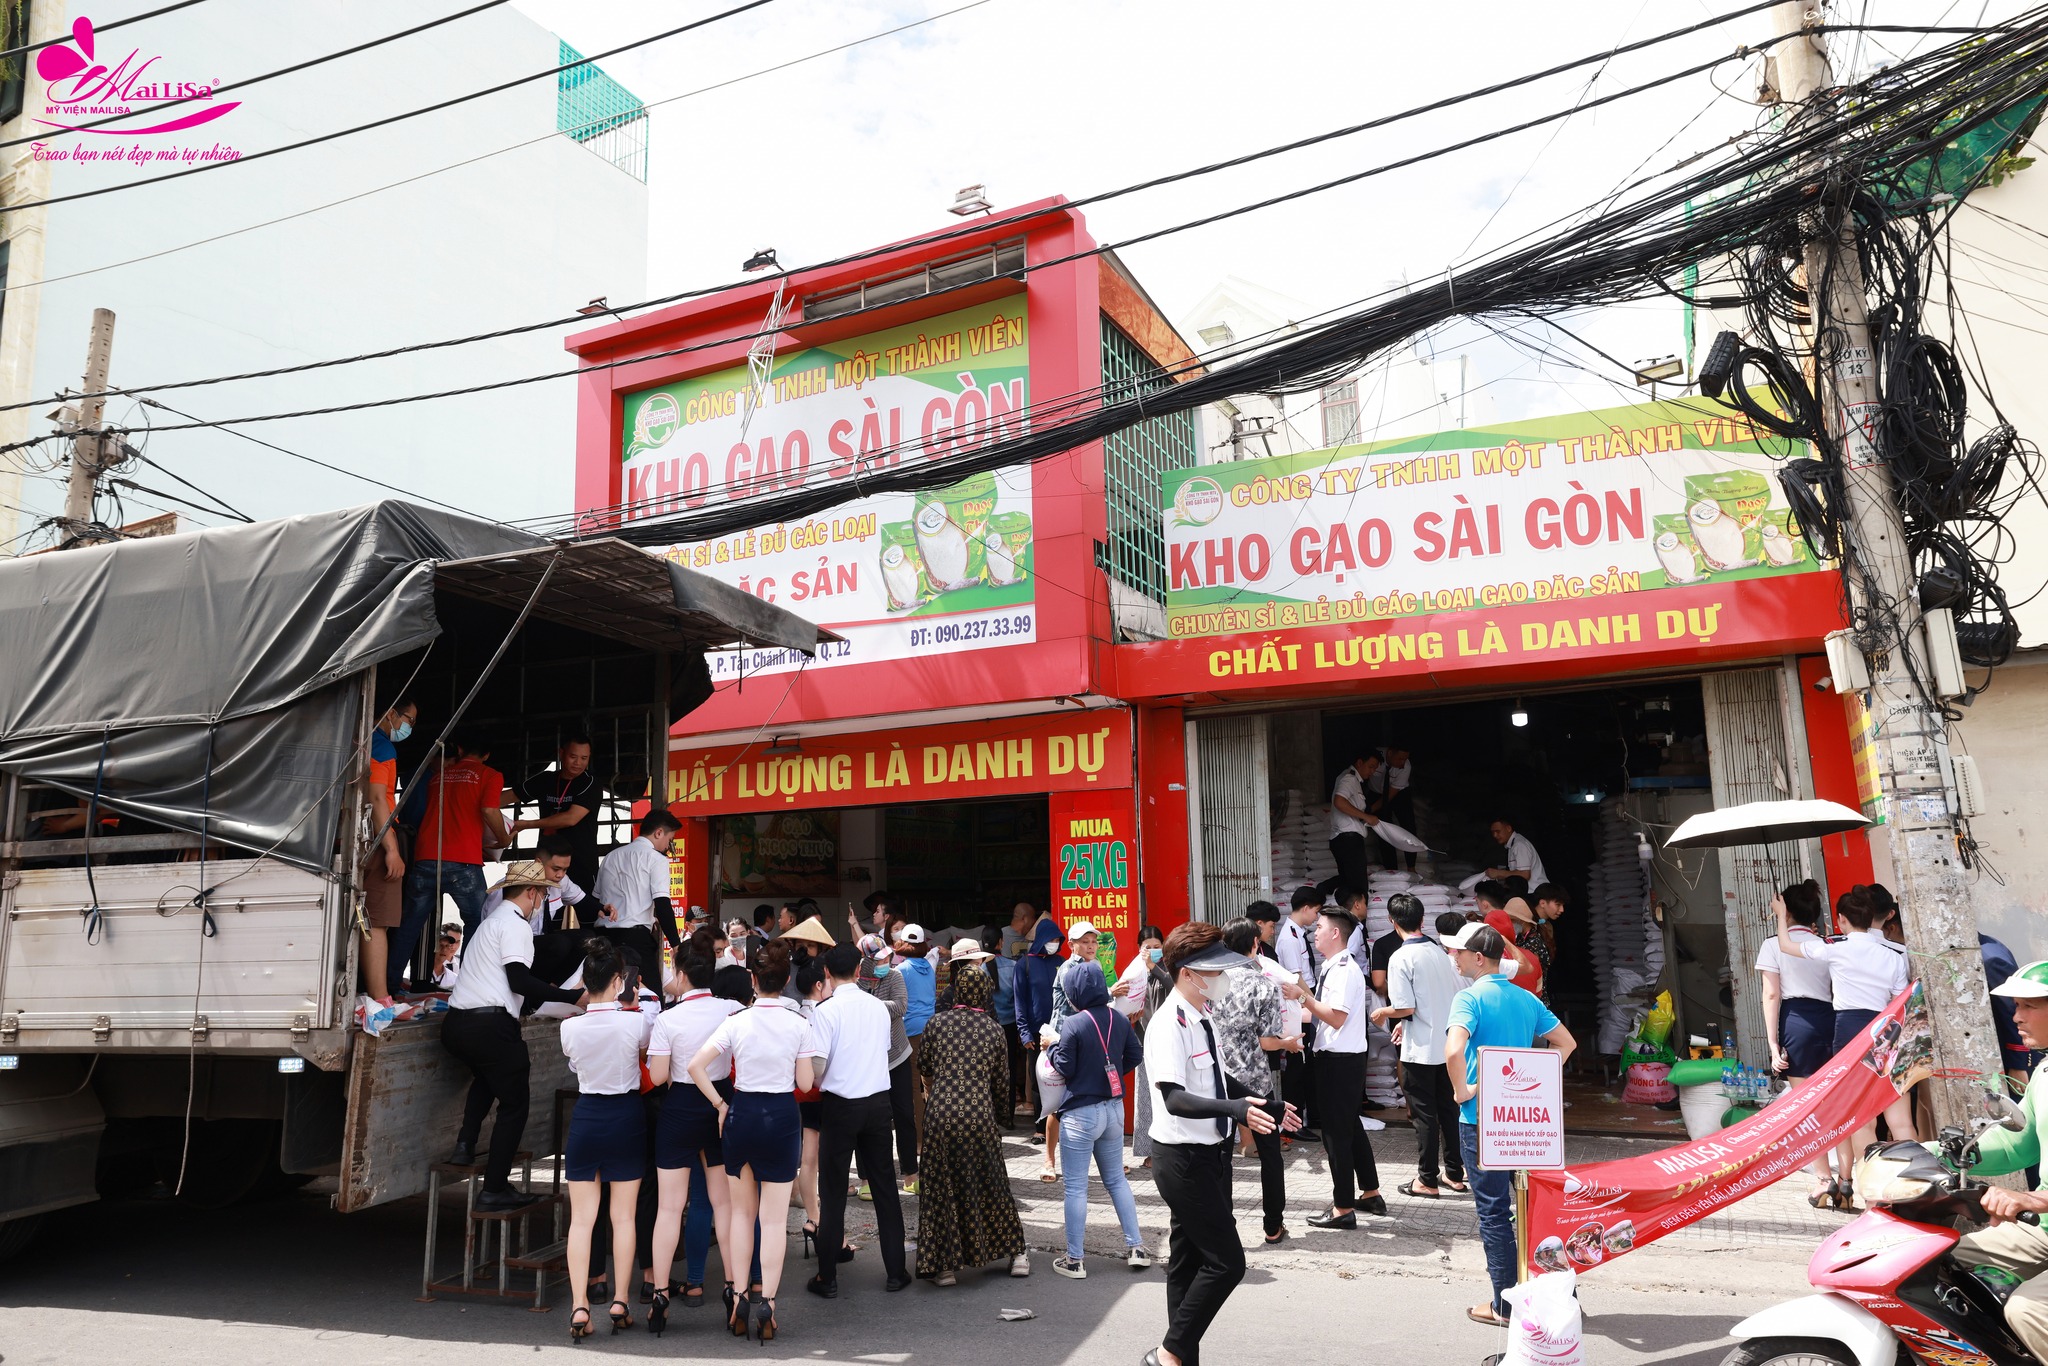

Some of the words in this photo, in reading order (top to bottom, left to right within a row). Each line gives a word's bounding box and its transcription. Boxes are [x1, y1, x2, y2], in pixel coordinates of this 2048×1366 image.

[686, 388, 735, 425] CÔNG
[741, 382, 767, 411] TY
[772, 366, 826, 404] TNHH
[834, 350, 880, 390] MỘT
[886, 334, 961, 376] THÀNH
[968, 314, 1023, 357] VIÊN
[1848, 364, 1863, 374] 13
[628, 452, 709, 522] KHO
[724, 429, 810, 501] GẠO
[828, 396, 900, 480] SÀI
[921, 374, 1022, 461] GÒN
[1230, 475, 1312, 508] CÔNG
[1320, 468, 1361, 496] TY
[1370, 454, 1460, 488] TNHH
[1472, 438, 1546, 476] MỘT
[1557, 424, 1682, 464] THÀNH
[715, 542, 730, 564] &
[734, 528, 756, 560] LẺ
[760, 523, 786, 556] ĐỦ
[790, 519, 828, 550] CÁC
[832, 512, 876, 542] LOẠI
[1170, 533, 1270, 590] KHO
[1290, 518, 1392, 584] GẠO
[1413, 494, 1502, 562] SÀI
[1524, 480, 1645, 550] GÒN
[790, 556, 858, 602] SẢN
[1170, 607, 1250, 636] CHUYÊN
[1256, 600, 1277, 628] SỈ
[1281, 606, 1298, 625] &
[1303, 594, 1330, 623] LẺ
[1337, 591, 1366, 620] ĐỦ
[1372, 589, 1417, 615] CÁC
[1423, 586, 1474, 612] LOẠI
[1480, 582, 1528, 608] GẠO
[1534, 574, 1584, 601] ĐẶC
[1590, 566, 1641, 597] SẢN
[717, 658, 727, 674] P.
[730, 654, 750, 672] Tân
[752, 648, 786, 669] Chánh
[820, 642, 832, 660] Q.
[837, 638, 851, 656] 12
[910, 628, 932, 647] ĐT:
[935, 614, 1032, 644] 090.237.33.99
[1208, 636, 1302, 677] CHẤT
[1314, 631, 1444, 670] LƯỢNG
[1457, 620, 1508, 656] LÀ
[1520, 614, 1642, 651] DANH
[1656, 602, 1723, 643] DỰ
[648, 754, 728, 804] HẤT
[738, 754, 852, 802] LƯỢNG
[865, 742, 910, 788] LÀ
[924, 738, 1032, 784] DANH
[1048, 728, 1110, 782] DỰ
[1070, 818, 1114, 838] MUA
[1060, 840, 1128, 890] 25KG
[1063, 891, 1092, 910] TRỞ
[1098, 892, 1127, 909] LÊN
[1093, 912, 1113, 929] GIÁ
[1116, 910, 1128, 929] SỈ
[1493, 1106, 1550, 1123] MAILISA
[1653, 1142, 1733, 1176] MAILISA
[1726, 1126, 1759, 1145] Chung
[1754, 1119, 1772, 1136] Tay
[1796, 1090, 1816, 1108] Trao
[1697, 1196, 1712, 1212] YÊN
[1726, 1181, 1741, 1197] LÀO
[1752, 1166, 1770, 1182] CAO
[1788, 1144, 1805, 1162] PHÚ
[1817, 1128, 1839, 1147] TUYÊN
